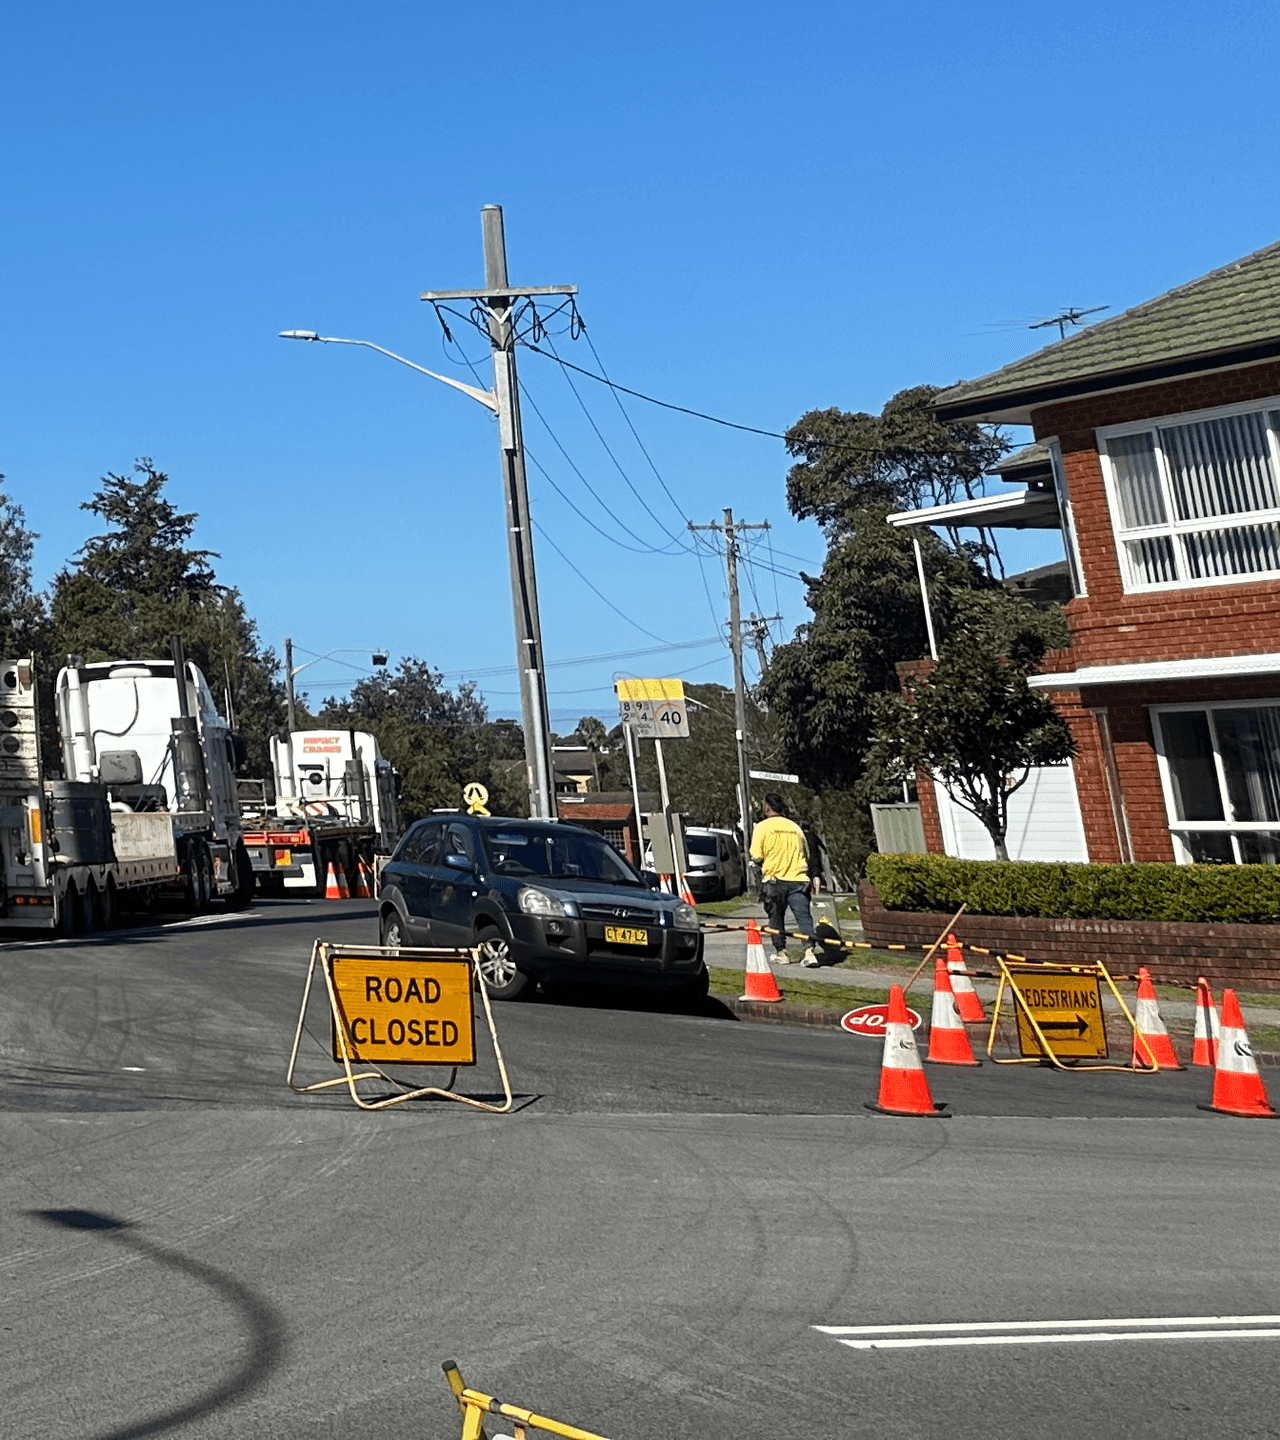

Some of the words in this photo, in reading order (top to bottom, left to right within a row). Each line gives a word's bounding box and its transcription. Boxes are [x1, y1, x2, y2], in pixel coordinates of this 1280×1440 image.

[660, 710, 682, 725] 40
[365, 976, 441, 1004] ROAD
[1019, 988, 1097, 1009] PEDESTRIANS
[351, 1017, 459, 1047] CLOSED
